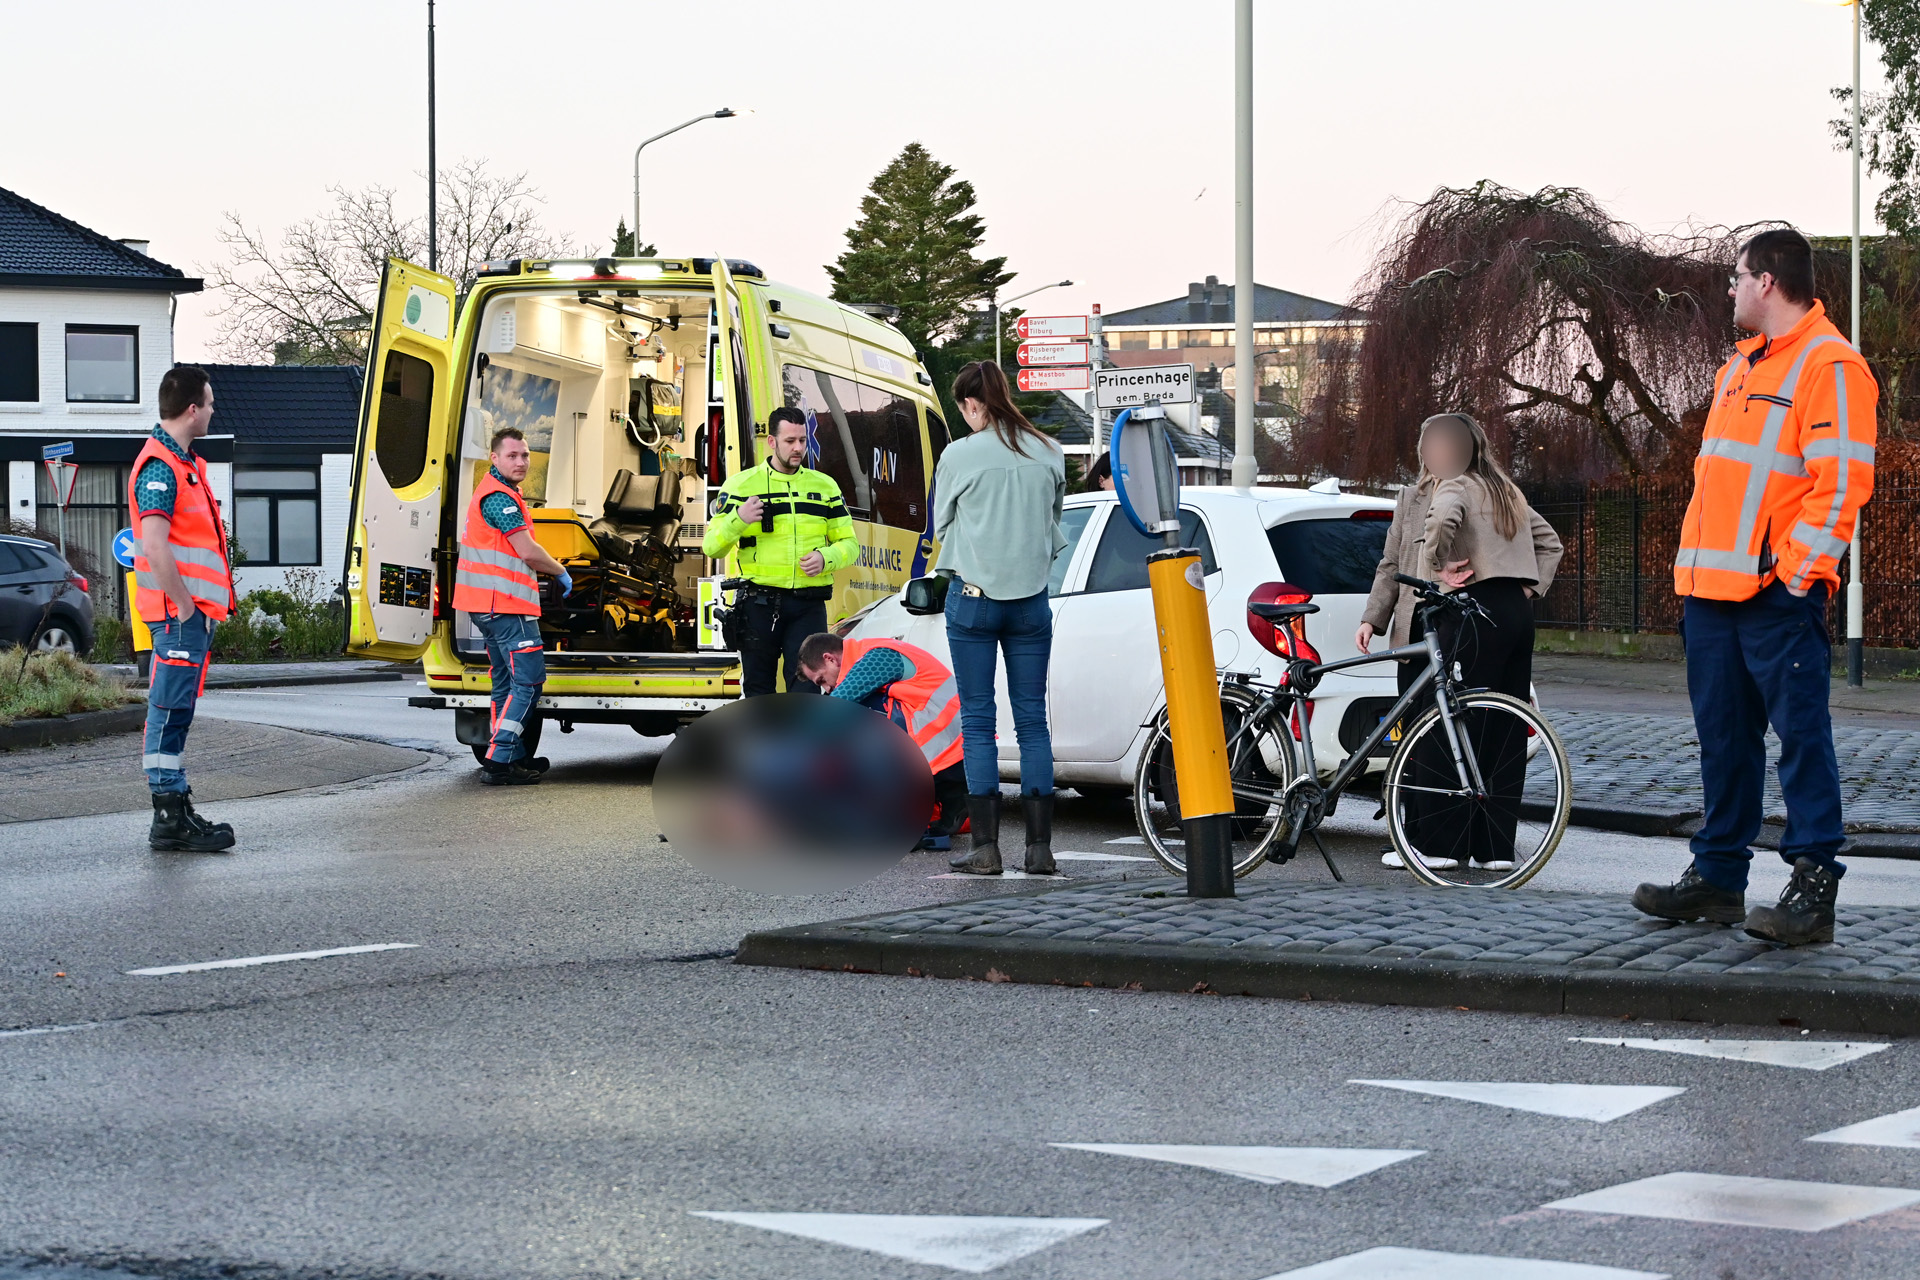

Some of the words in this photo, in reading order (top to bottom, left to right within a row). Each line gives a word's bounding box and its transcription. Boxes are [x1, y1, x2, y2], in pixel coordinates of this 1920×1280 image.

[1029, 346, 1065, 354] Rijsbergen
[1097, 372, 1190, 388] Princenhage
[1115, 394, 1142, 404] gem.
[1143, 391, 1174, 400] Breda
[851, 545, 902, 572] MBULANCE
